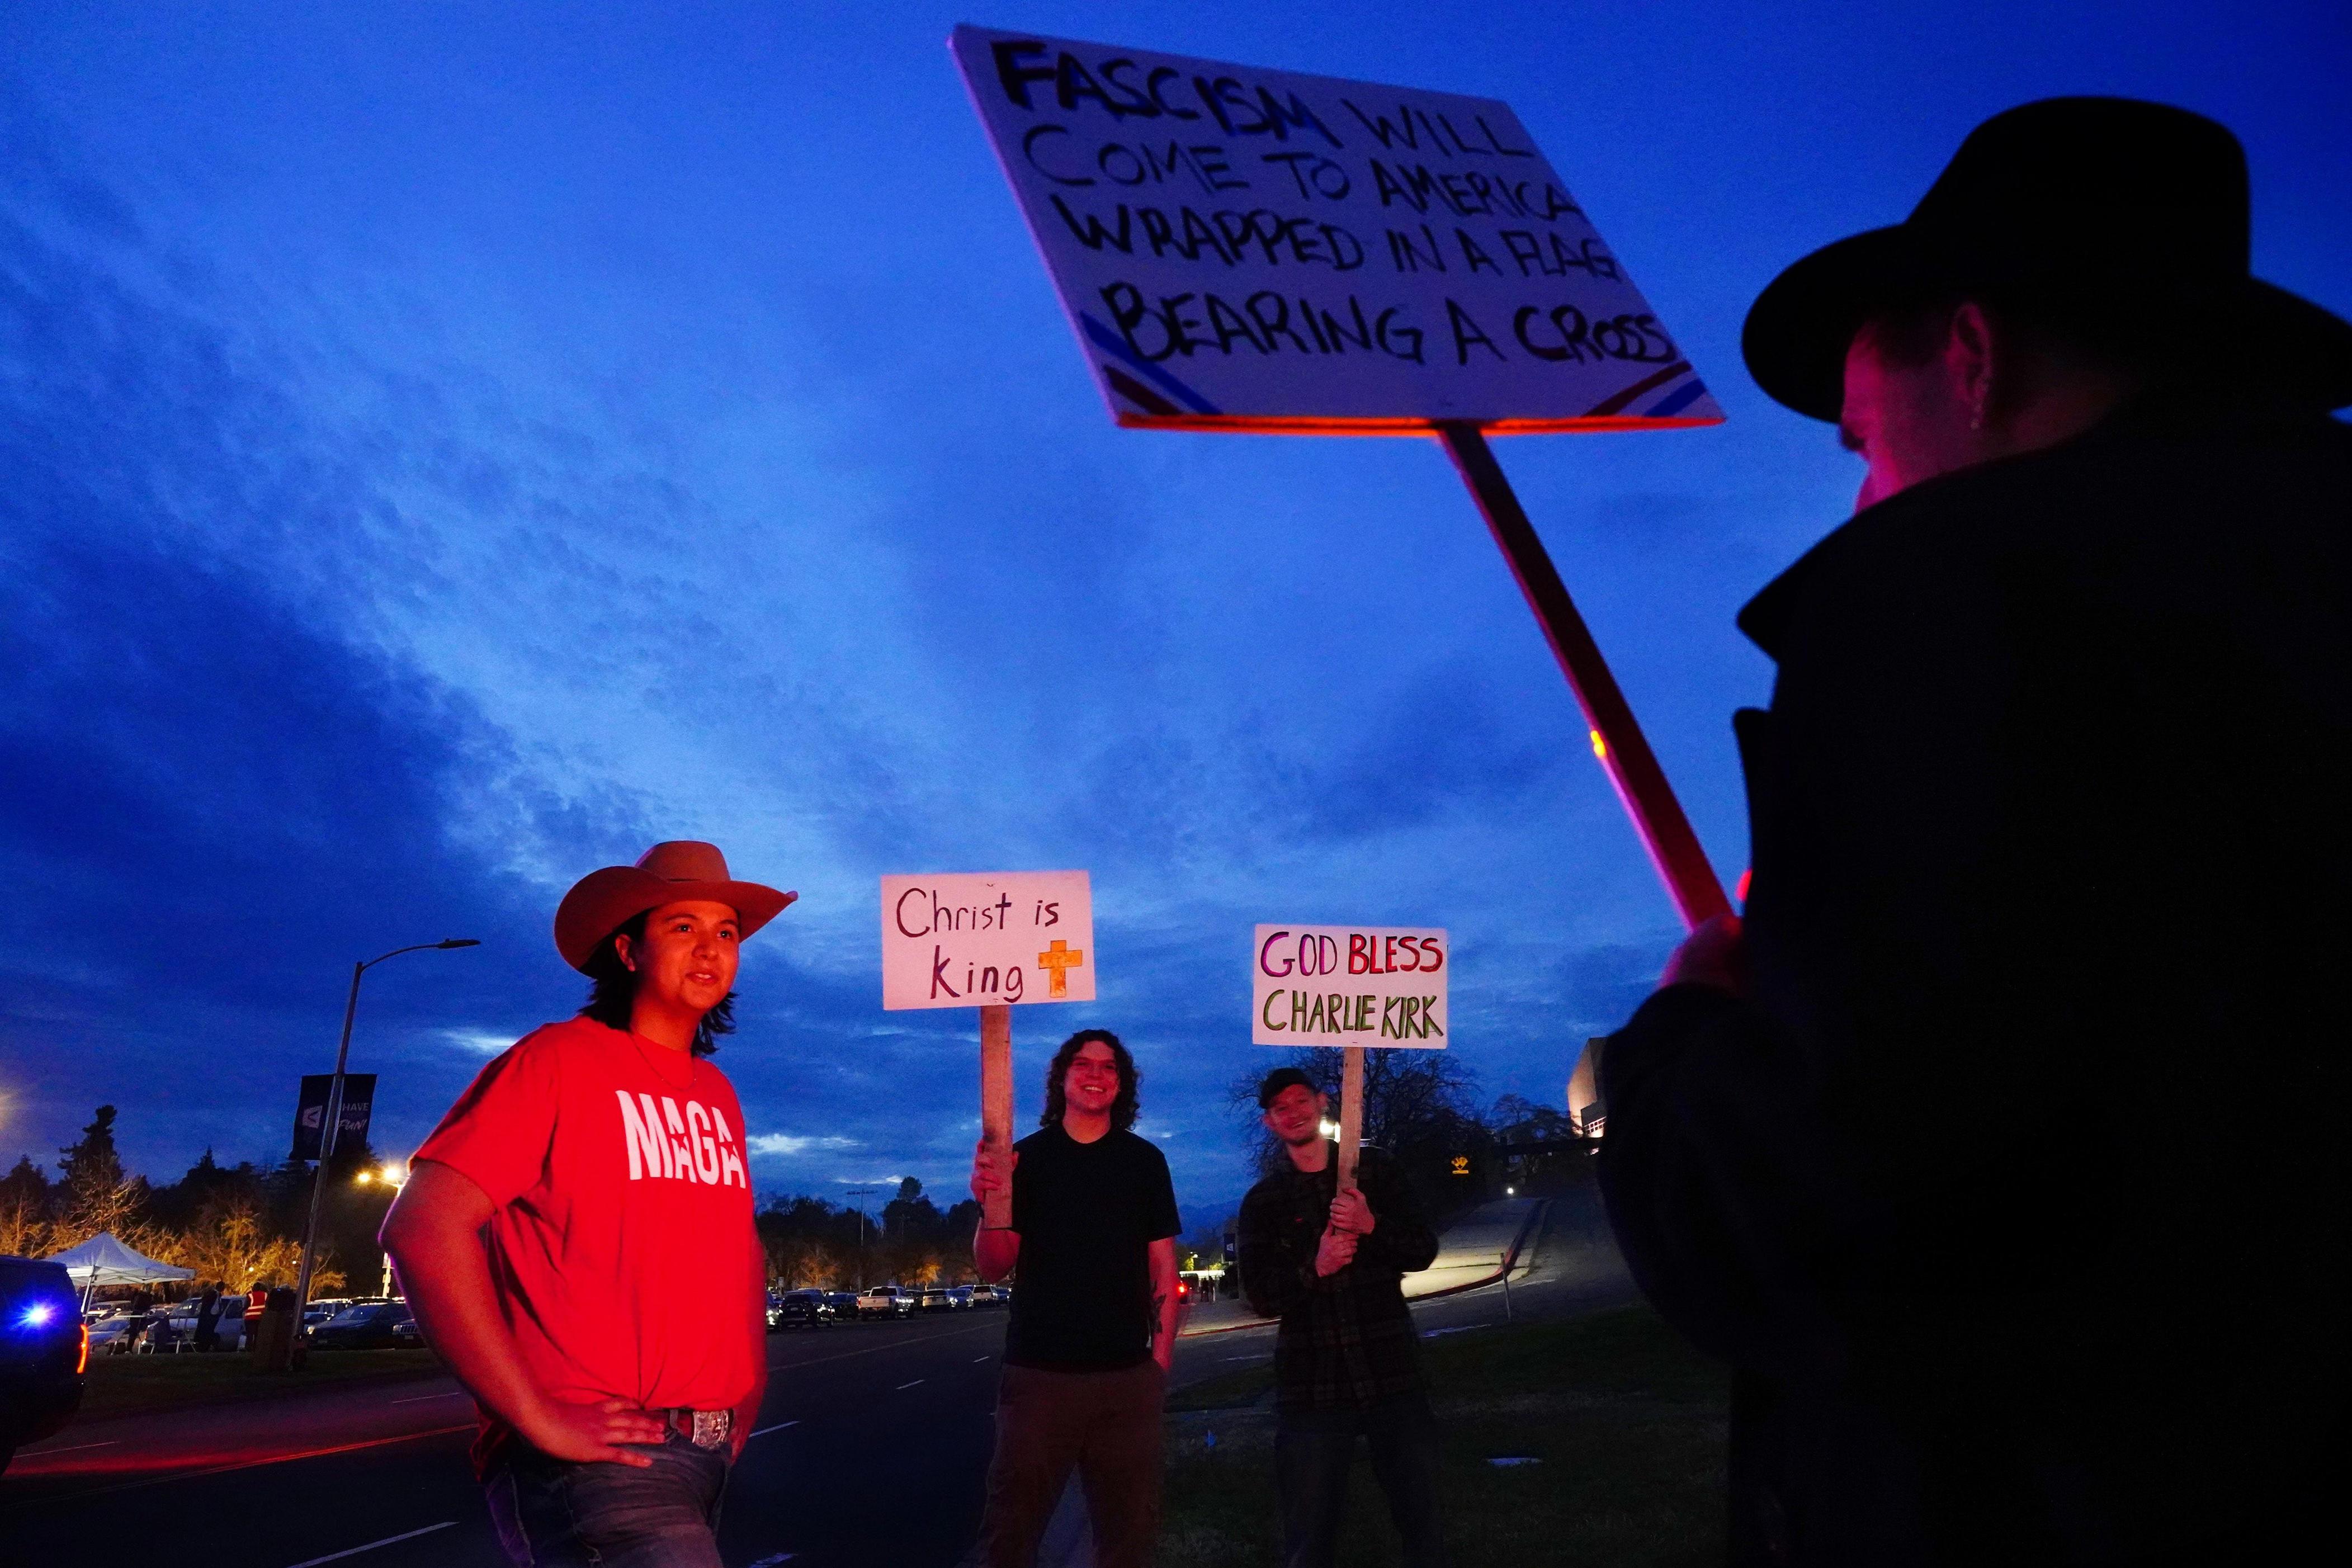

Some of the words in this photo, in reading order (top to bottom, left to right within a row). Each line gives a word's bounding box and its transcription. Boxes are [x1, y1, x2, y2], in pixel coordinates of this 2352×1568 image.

[990, 41, 1343, 149] FASCISM
[1342, 98, 1536, 158] WILL
[1023, 124, 1251, 195] COME
[1262, 151, 1350, 201] TO
[1369, 158, 1584, 222] AMERICA
[1050, 193, 1364, 271] WRAPPED
[1386, 224, 1447, 273] IN
[1455, 227, 1504, 277] A
[1499, 230, 1621, 282] FLAG
[1098, 281, 1425, 365] BEARING
[1445, 297, 1507, 365] A
[1514, 305, 1677, 365] CROSS
[896, 887, 1012, 938] Christ
[1035, 900, 1059, 927] is
[930, 944, 1024, 1003] King
[1260, 931, 1338, 977] GOD
[1348, 933, 1443, 974] BLESS
[1263, 989, 1376, 1034] CHARLIE
[1381, 994, 1444, 1040] KIRK
[342, 1102, 369, 1112] HAVE
[615, 1090, 746, 1189] MAGA
